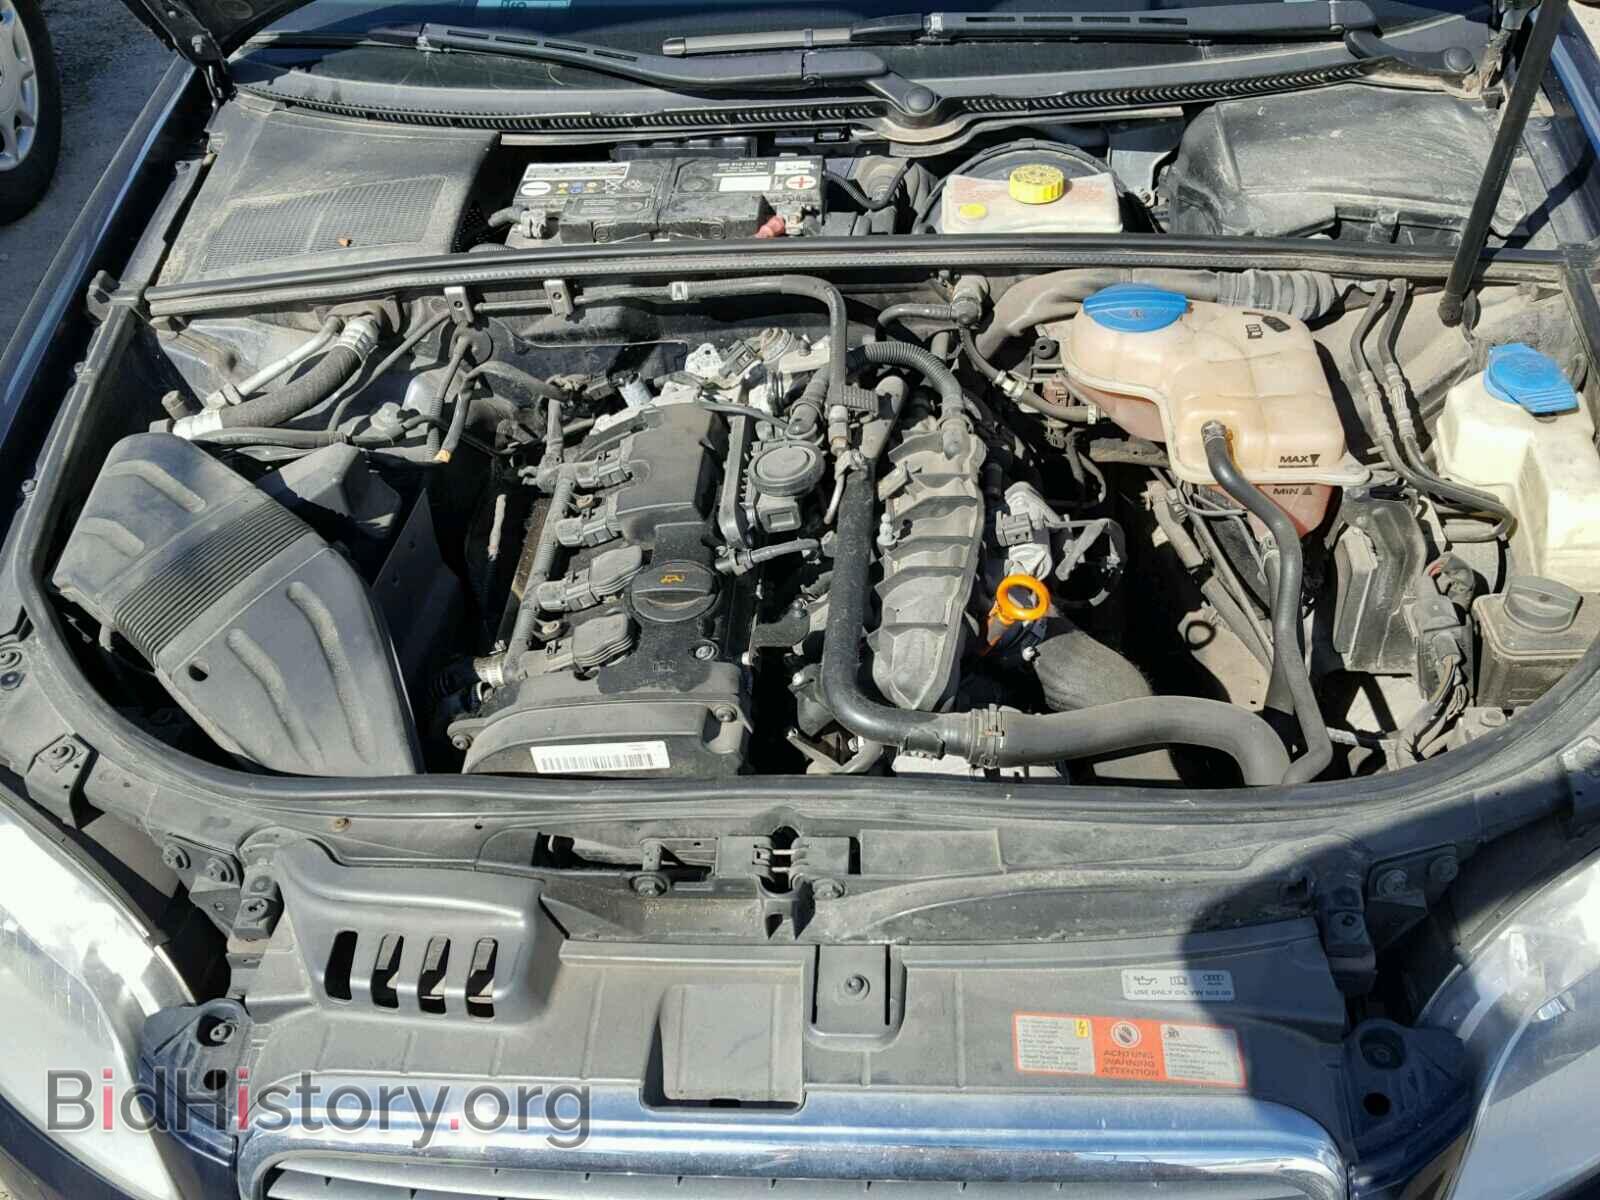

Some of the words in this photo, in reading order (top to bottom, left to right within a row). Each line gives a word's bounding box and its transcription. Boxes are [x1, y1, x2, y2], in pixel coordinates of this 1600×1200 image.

[1279, 455, 1309, 463] MAX
[1272, 487, 1299, 495] MIN
[1103, 1057, 1156, 1068] WARNING
[1101, 1066, 1160, 1077] ATTENTION
